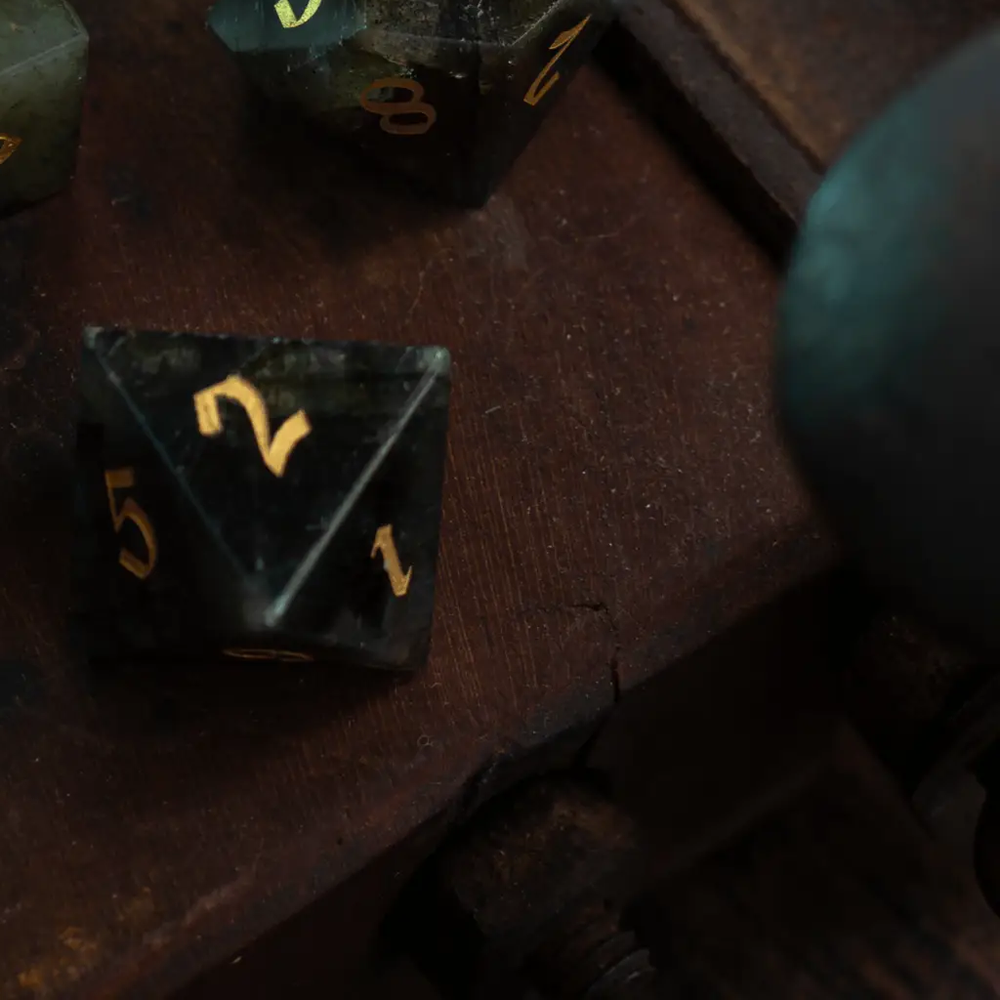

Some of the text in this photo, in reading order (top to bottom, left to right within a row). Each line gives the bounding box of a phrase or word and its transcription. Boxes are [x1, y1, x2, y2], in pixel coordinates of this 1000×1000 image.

[360, 76, 438, 136] 8
[523, 13, 592, 107] 2
[192, 373, 314, 479] 2
[103, 465, 159, 580] 5
[369, 522, 414, 598] 1
